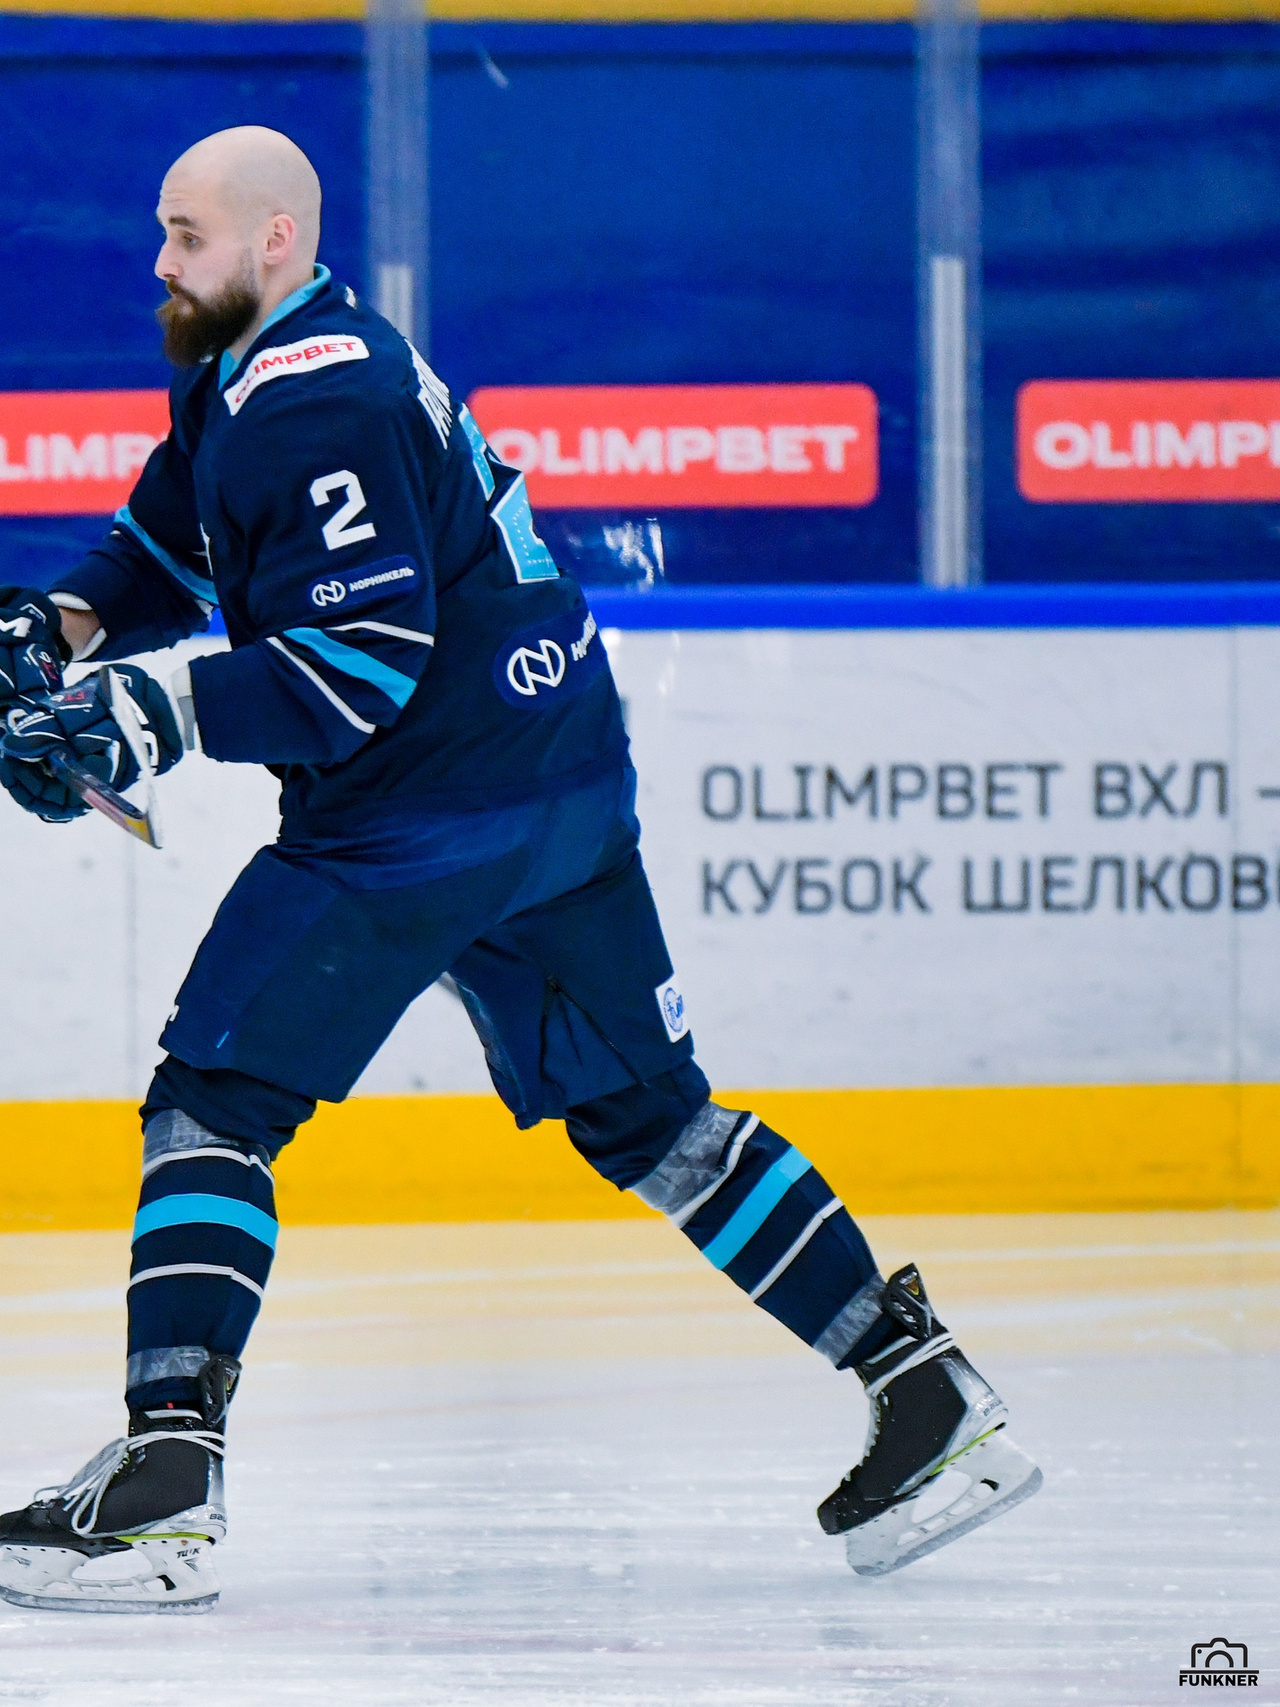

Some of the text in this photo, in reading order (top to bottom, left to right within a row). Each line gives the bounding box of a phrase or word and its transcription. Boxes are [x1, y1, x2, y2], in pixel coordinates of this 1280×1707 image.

[489, 424, 859, 475] OLIMPBET
[1033, 420, 1280, 469] OLIMP
[309, 470, 377, 550] 2
[349, 566, 415, 592] НОРНИКЕЛЬ
[701, 760, 1228, 822] OLIMPBET ВХЛ
[701, 852, 1280, 916] КУБОК ШЕЛКОВ
